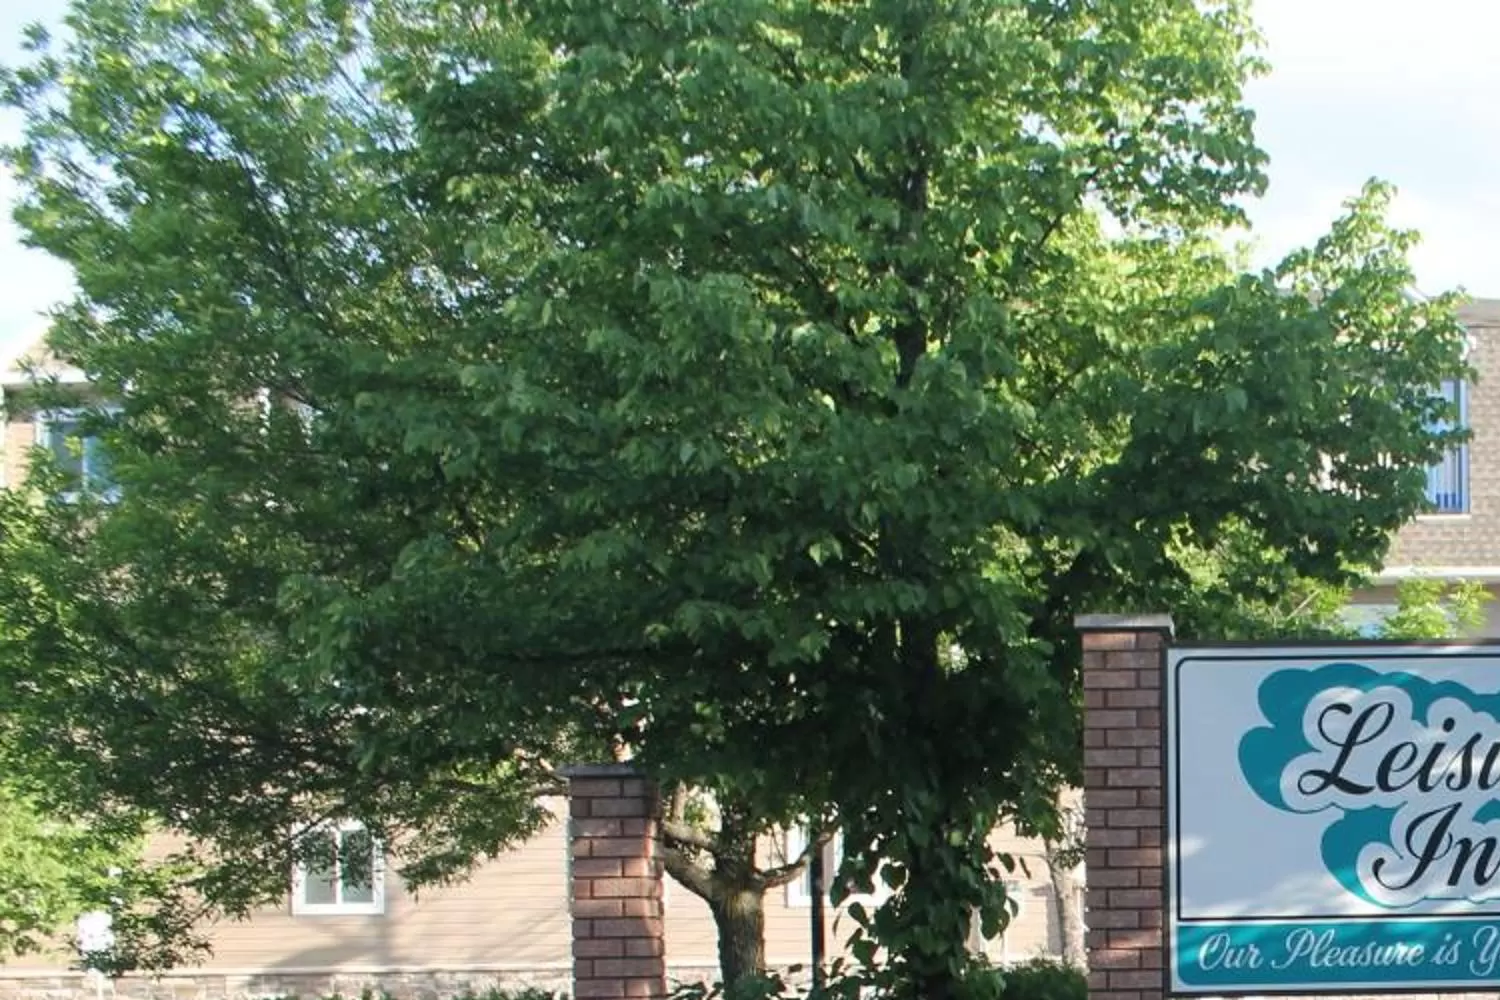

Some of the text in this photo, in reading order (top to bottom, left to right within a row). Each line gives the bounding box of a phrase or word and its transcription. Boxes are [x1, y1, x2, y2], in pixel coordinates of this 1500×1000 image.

[1199, 932, 1264, 971] Our
[1271, 927, 1424, 969] Pleasure
[1430, 933, 1462, 966] is
